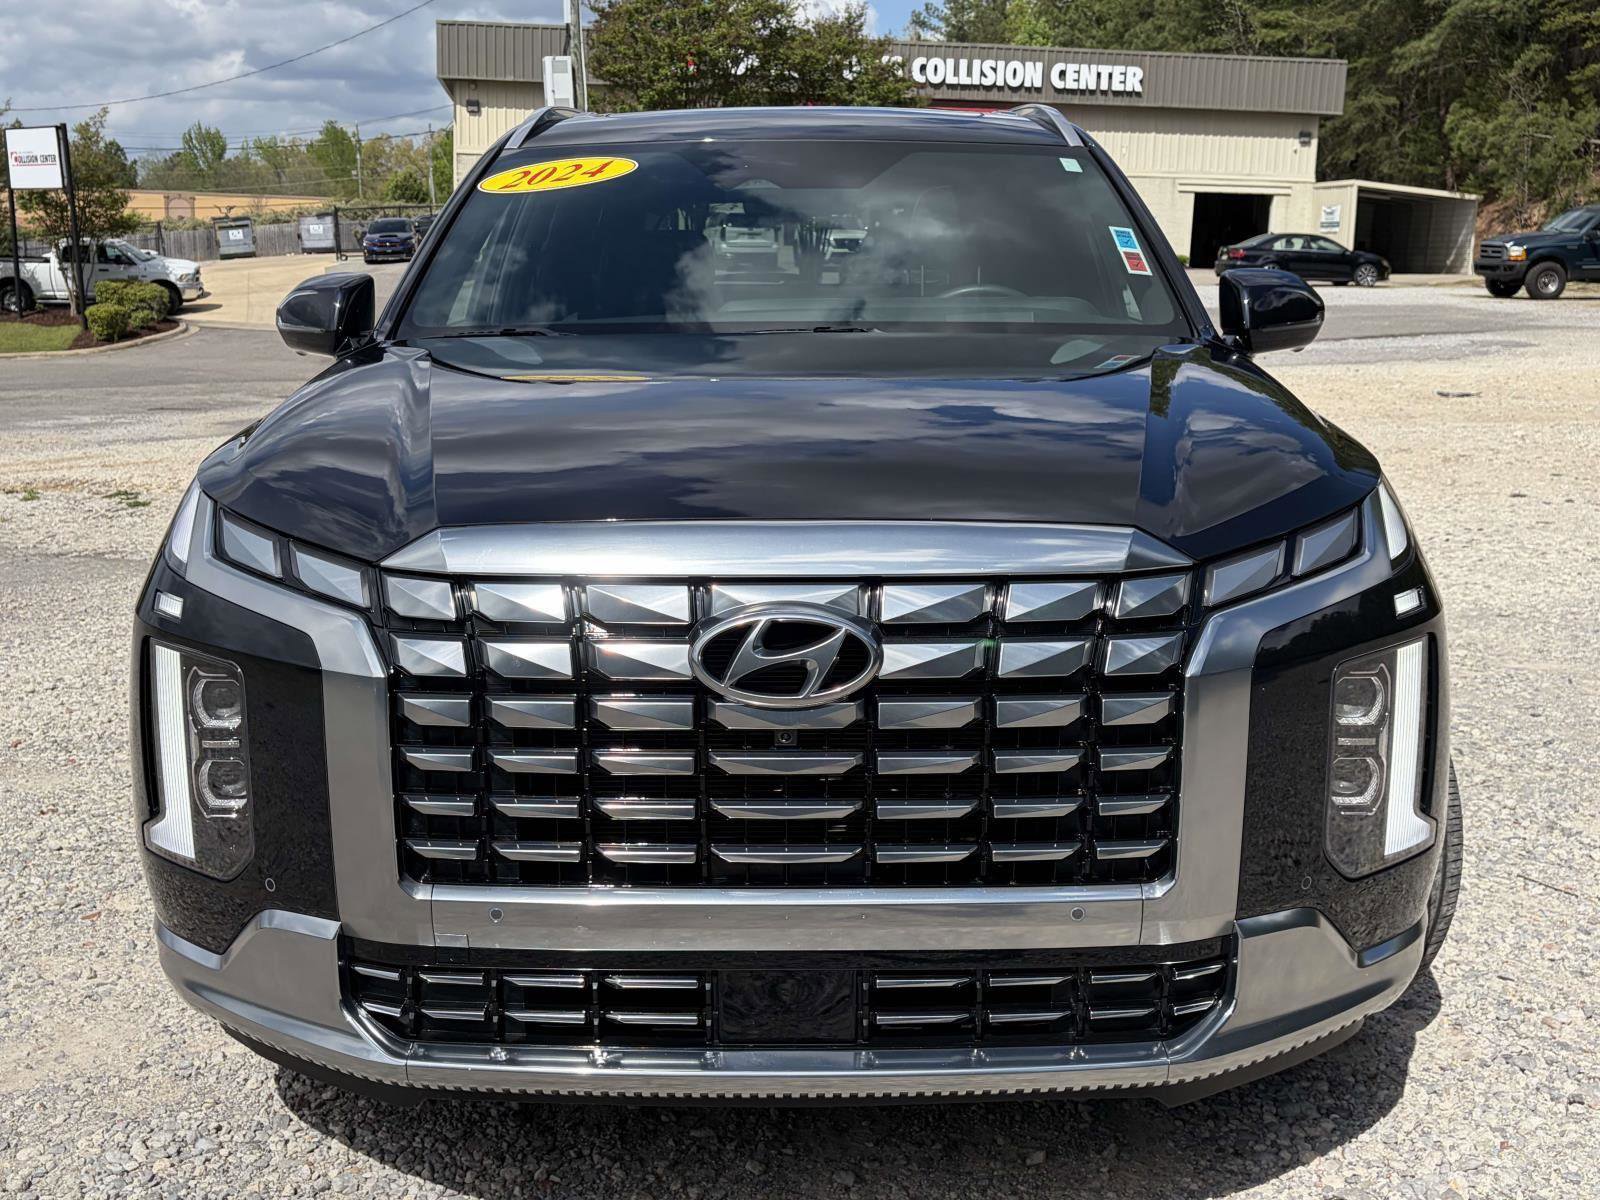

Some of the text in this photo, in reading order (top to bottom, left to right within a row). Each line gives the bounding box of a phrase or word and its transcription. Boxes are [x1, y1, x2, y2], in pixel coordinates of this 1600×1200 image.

[912, 56, 1043, 88] COLLISION
[1050, 62, 1143, 92] CENTER
[39, 154, 57, 163] CENTER
[498, 160, 615, 190] 2024
